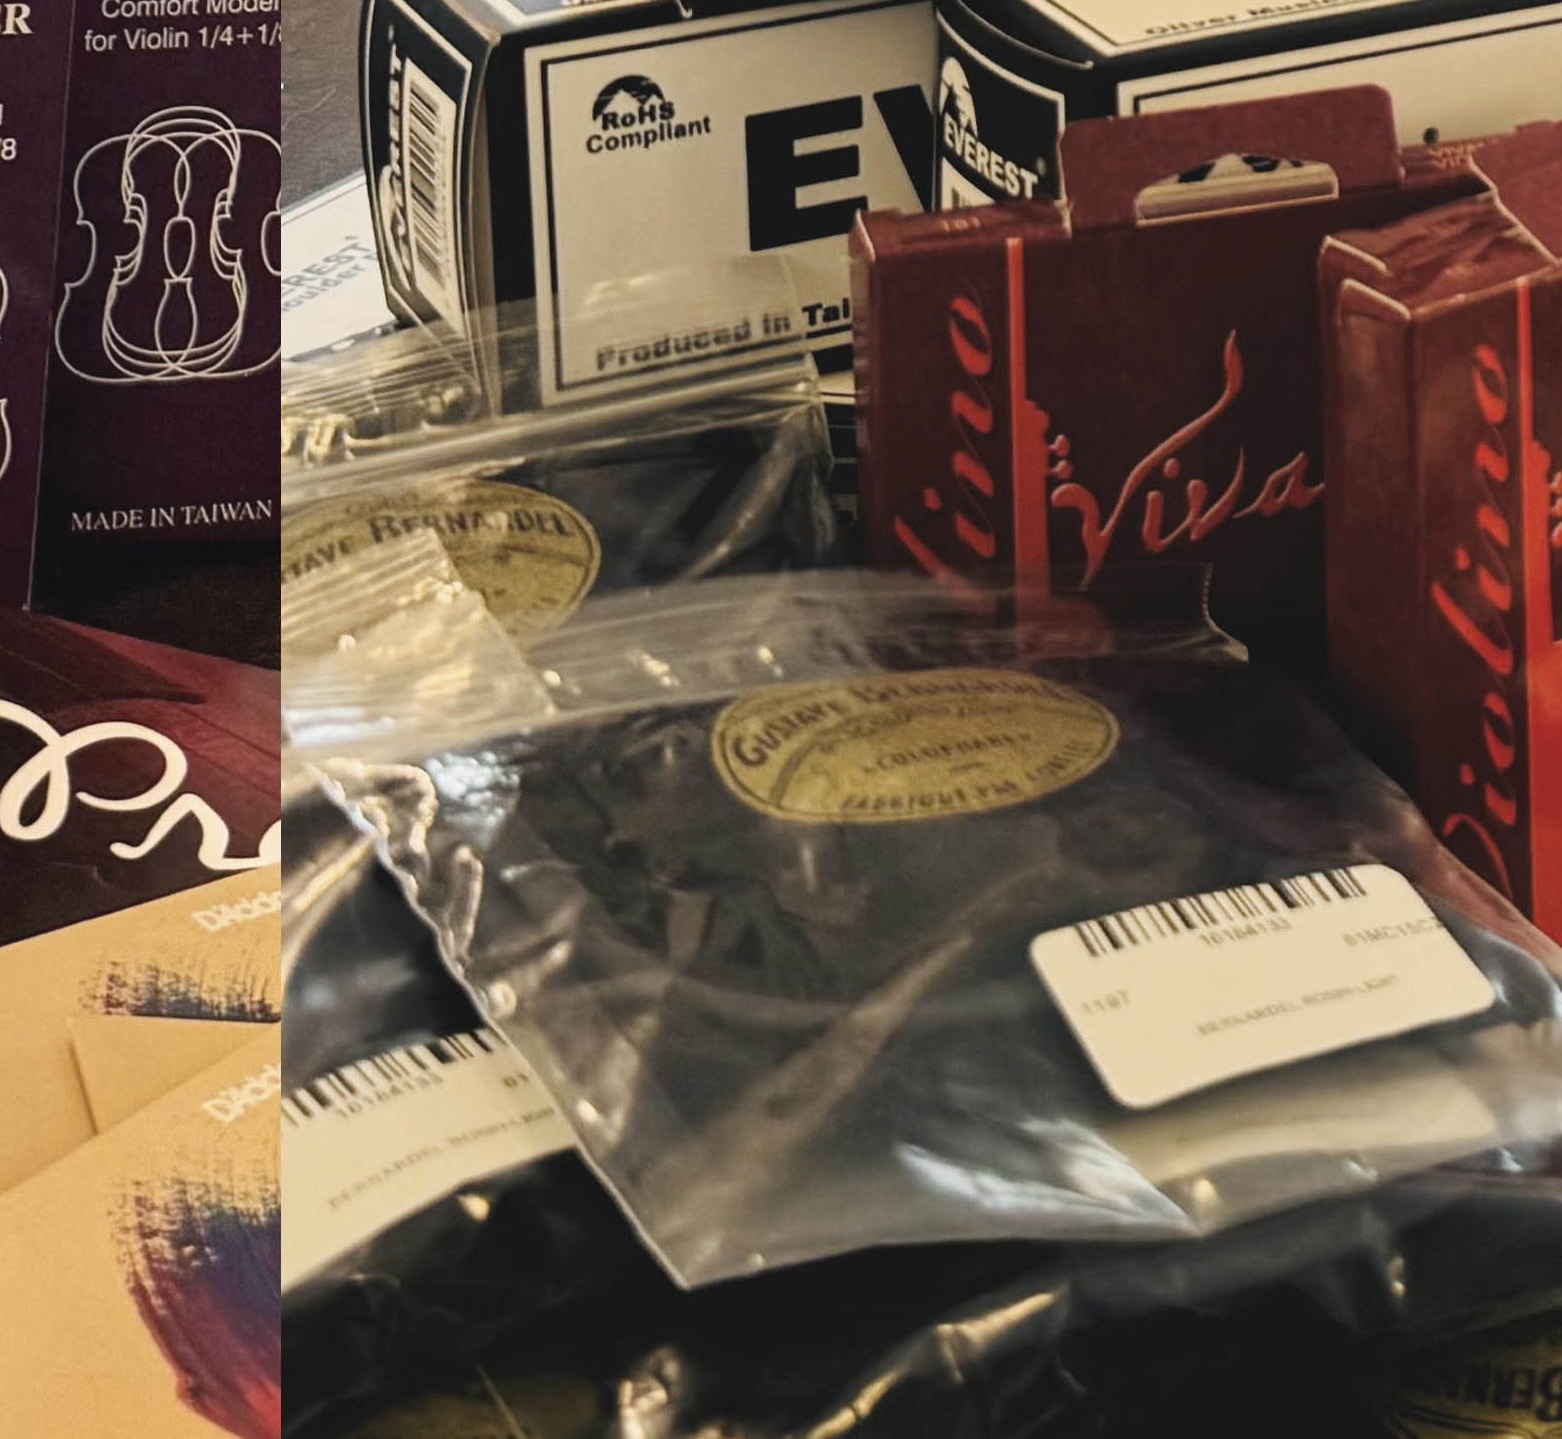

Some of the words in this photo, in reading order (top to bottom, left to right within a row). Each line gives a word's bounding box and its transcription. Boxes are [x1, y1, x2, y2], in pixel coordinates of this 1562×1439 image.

[85, 28, 117, 53] for
[122, 26, 190, 51] Violin
[585, 114, 713, 155] Compliant
[601, 99, 675, 133] RoHS
[943, 118, 1041, 200] EVEREST
[595, 319, 752, 373] Produced
[762, 310, 793, 335] in
[70, 507, 146, 533] MADE
[150, 507, 177, 530] IN
[182, 498, 273, 527] TAIWAN
